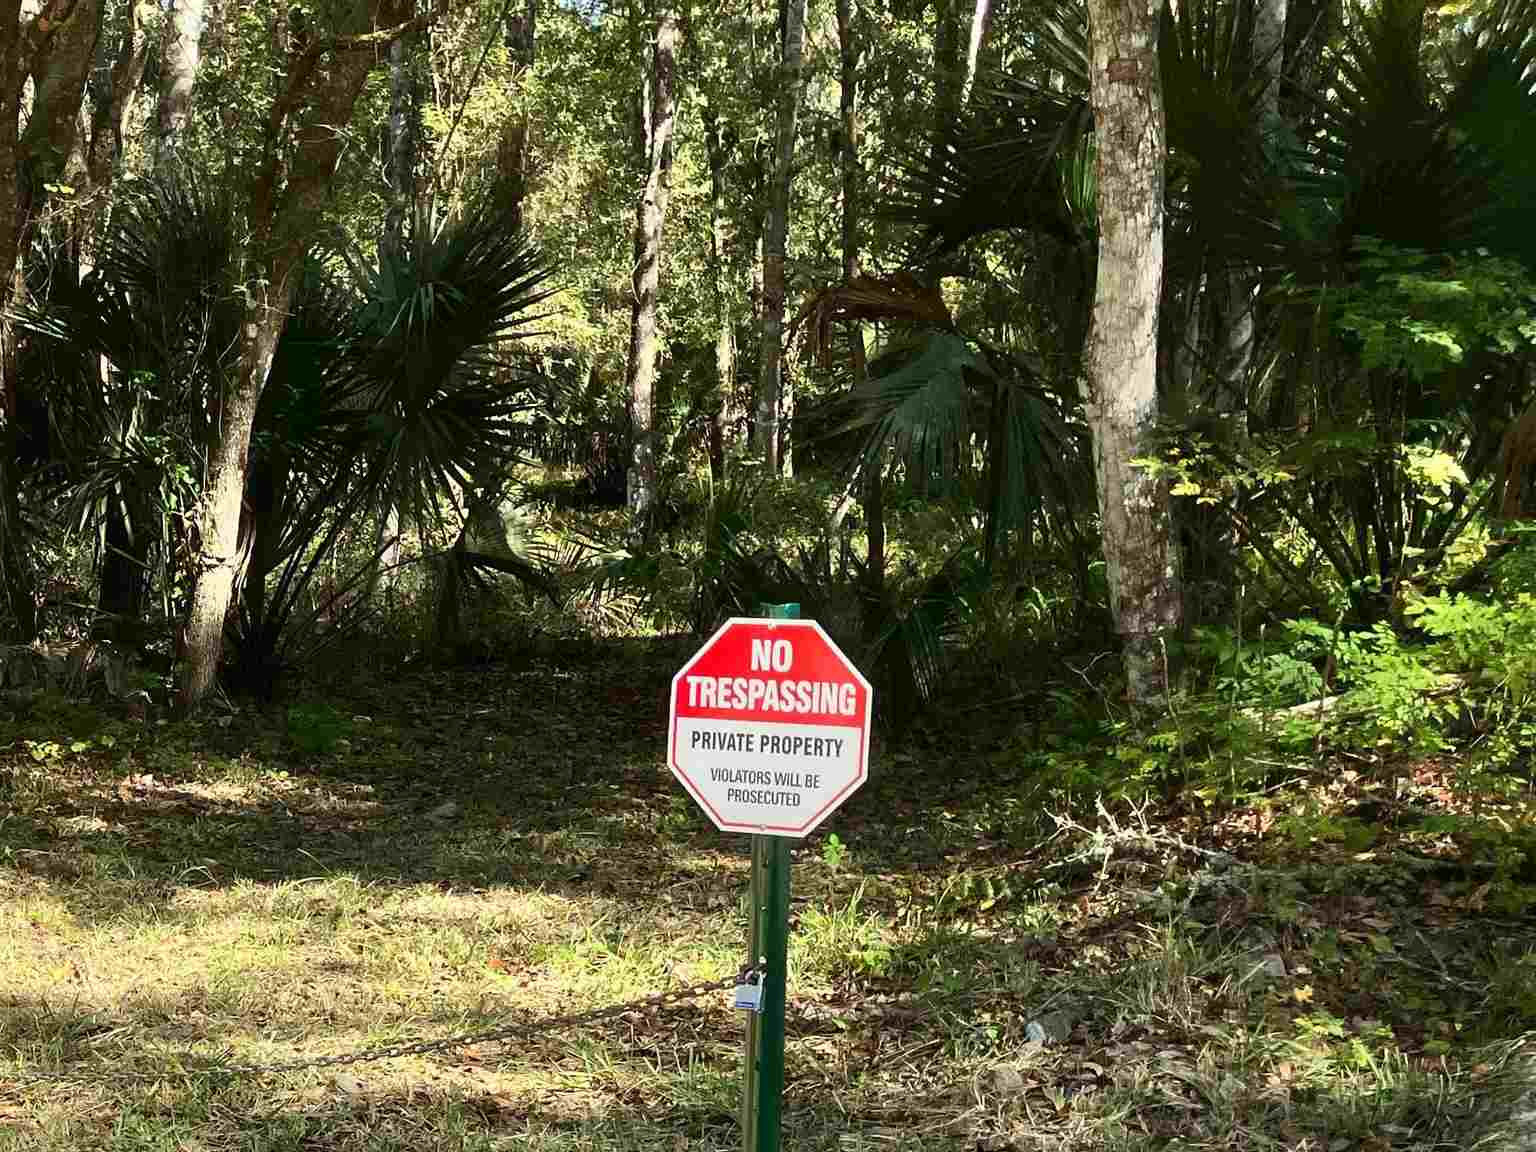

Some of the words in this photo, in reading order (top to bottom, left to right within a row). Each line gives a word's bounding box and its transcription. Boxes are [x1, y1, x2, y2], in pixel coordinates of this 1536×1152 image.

[750, 638, 793, 673] NO
[686, 676, 857, 716] TRESPASSING
[691, 730, 754, 753] PRIVATE
[760, 734, 843, 758] PROPERTY
[710, 767, 772, 786] VIOLATORS
[774, 772, 802, 788] WILL
[805, 774, 820, 789] BE
[727, 788, 801, 807] PROSECUTED
